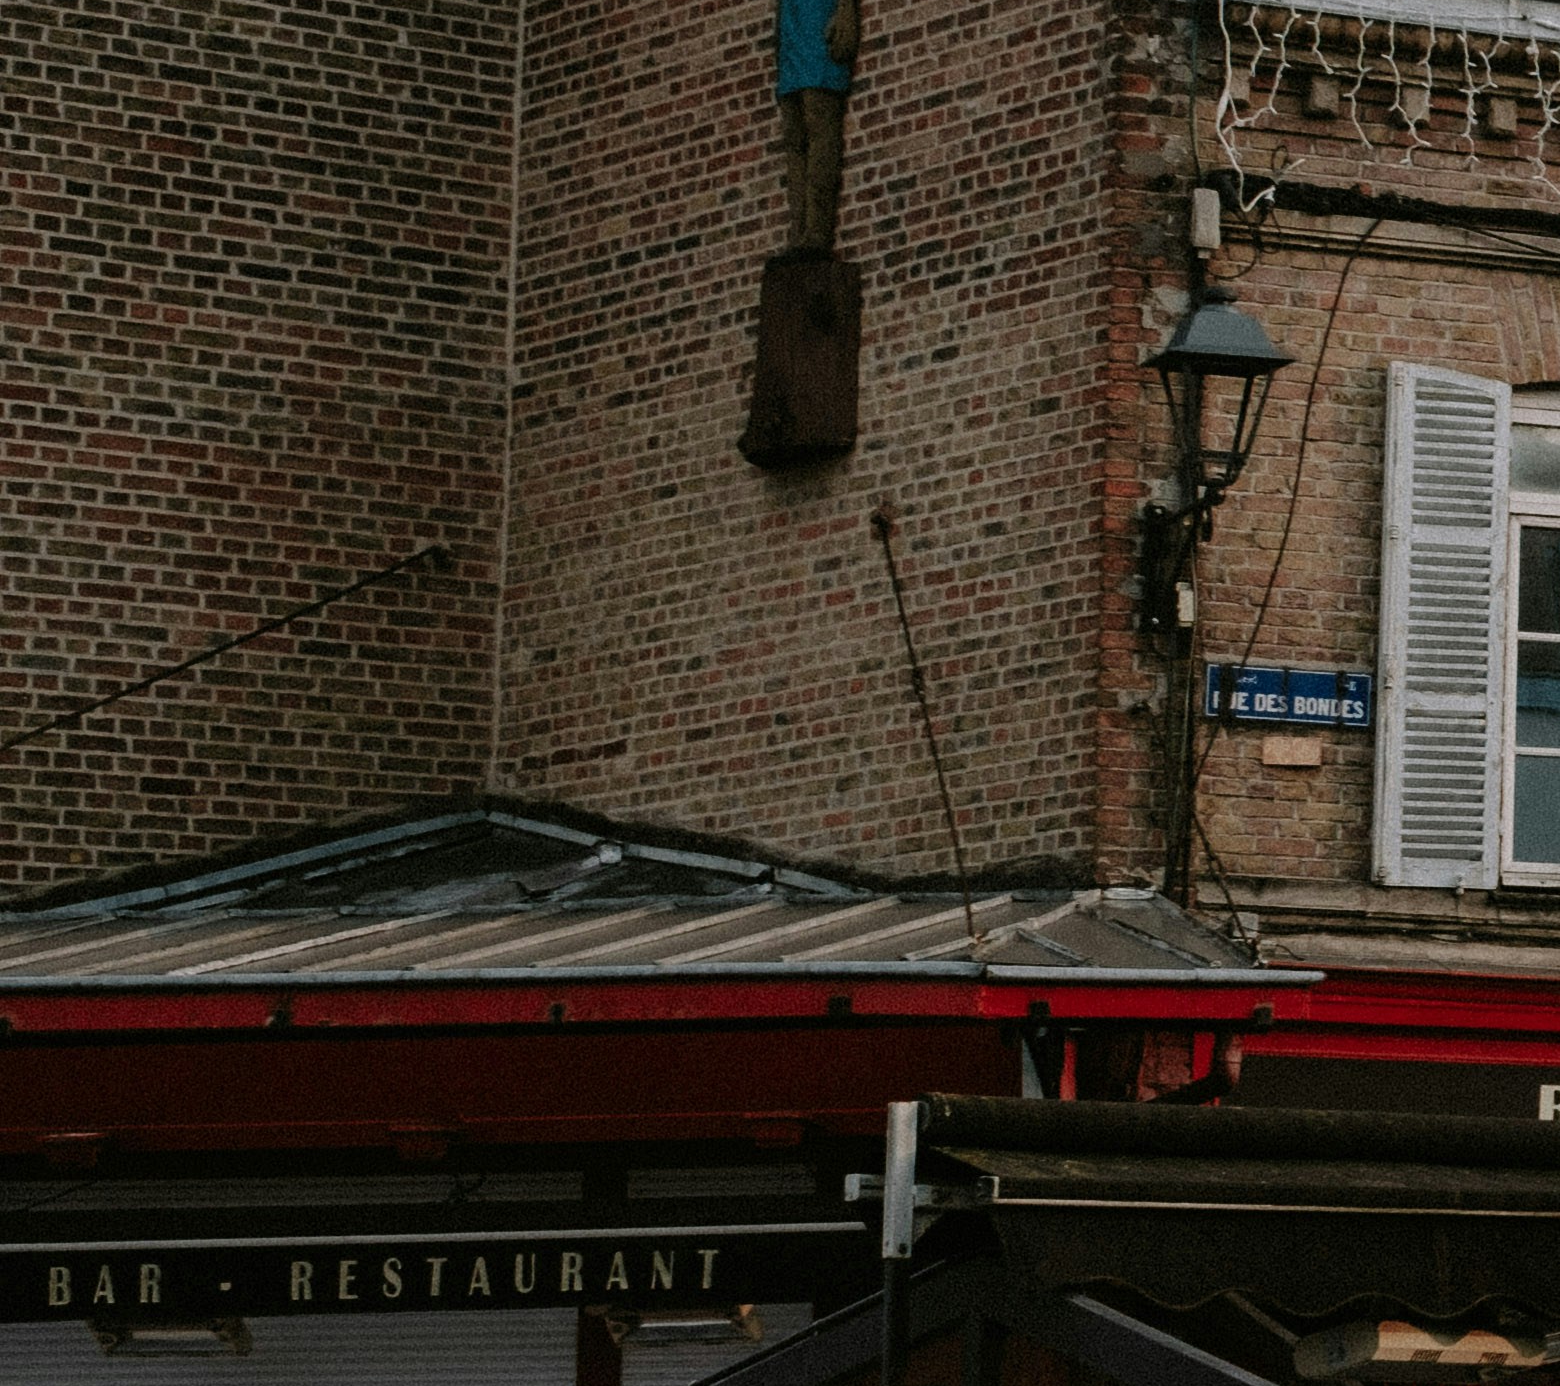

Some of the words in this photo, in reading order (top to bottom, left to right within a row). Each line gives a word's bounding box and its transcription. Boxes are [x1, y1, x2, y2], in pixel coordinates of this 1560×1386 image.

[1253, 692, 1289, 713] DES
[1293, 695, 1365, 719] BONDES
[47, 1263, 162, 1307] BAR
[290, 1248, 720, 1303] RESTAURANT
